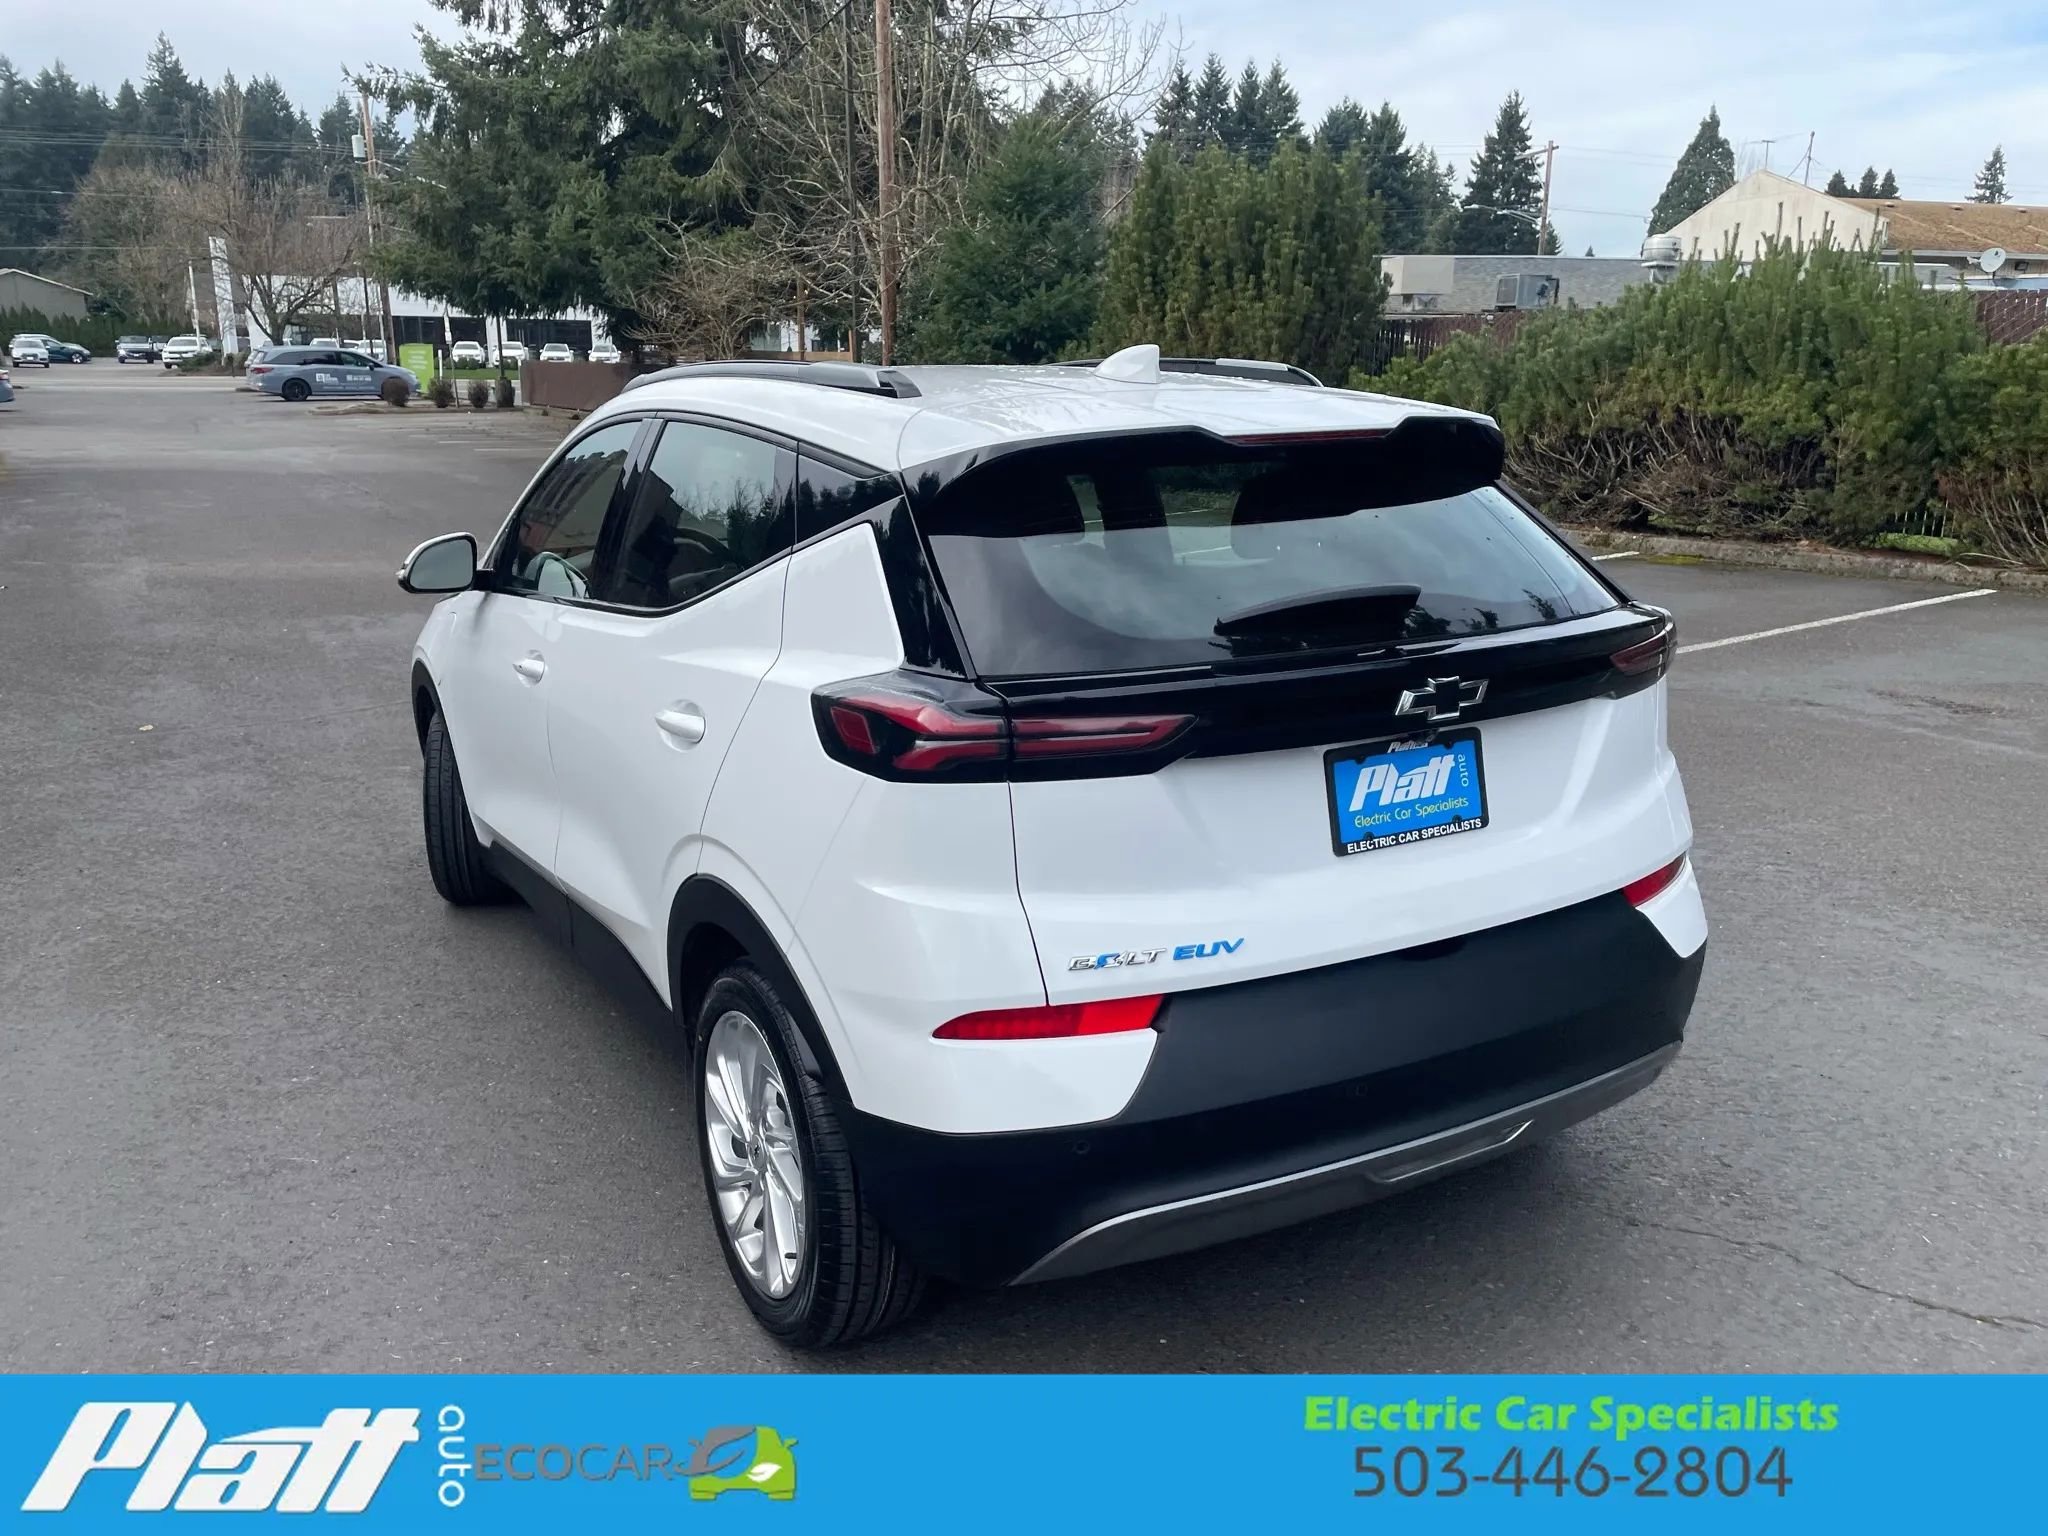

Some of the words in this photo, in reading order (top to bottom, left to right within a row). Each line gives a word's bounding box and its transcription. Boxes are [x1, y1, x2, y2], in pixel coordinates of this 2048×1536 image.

[1349, 755, 1455, 812] Platt
[1458, 754, 1469, 788] auto
[1355, 812, 1391, 828] Electric
[1395, 808, 1412, 821] Car
[1416, 797, 1469, 818] Specialists
[1347, 836, 1397, 854] ELECTRIC
[1399, 831, 1420, 844] CAR
[1422, 819, 1482, 840] SPECIALISTS
[1173, 938, 1245, 961] EUV
